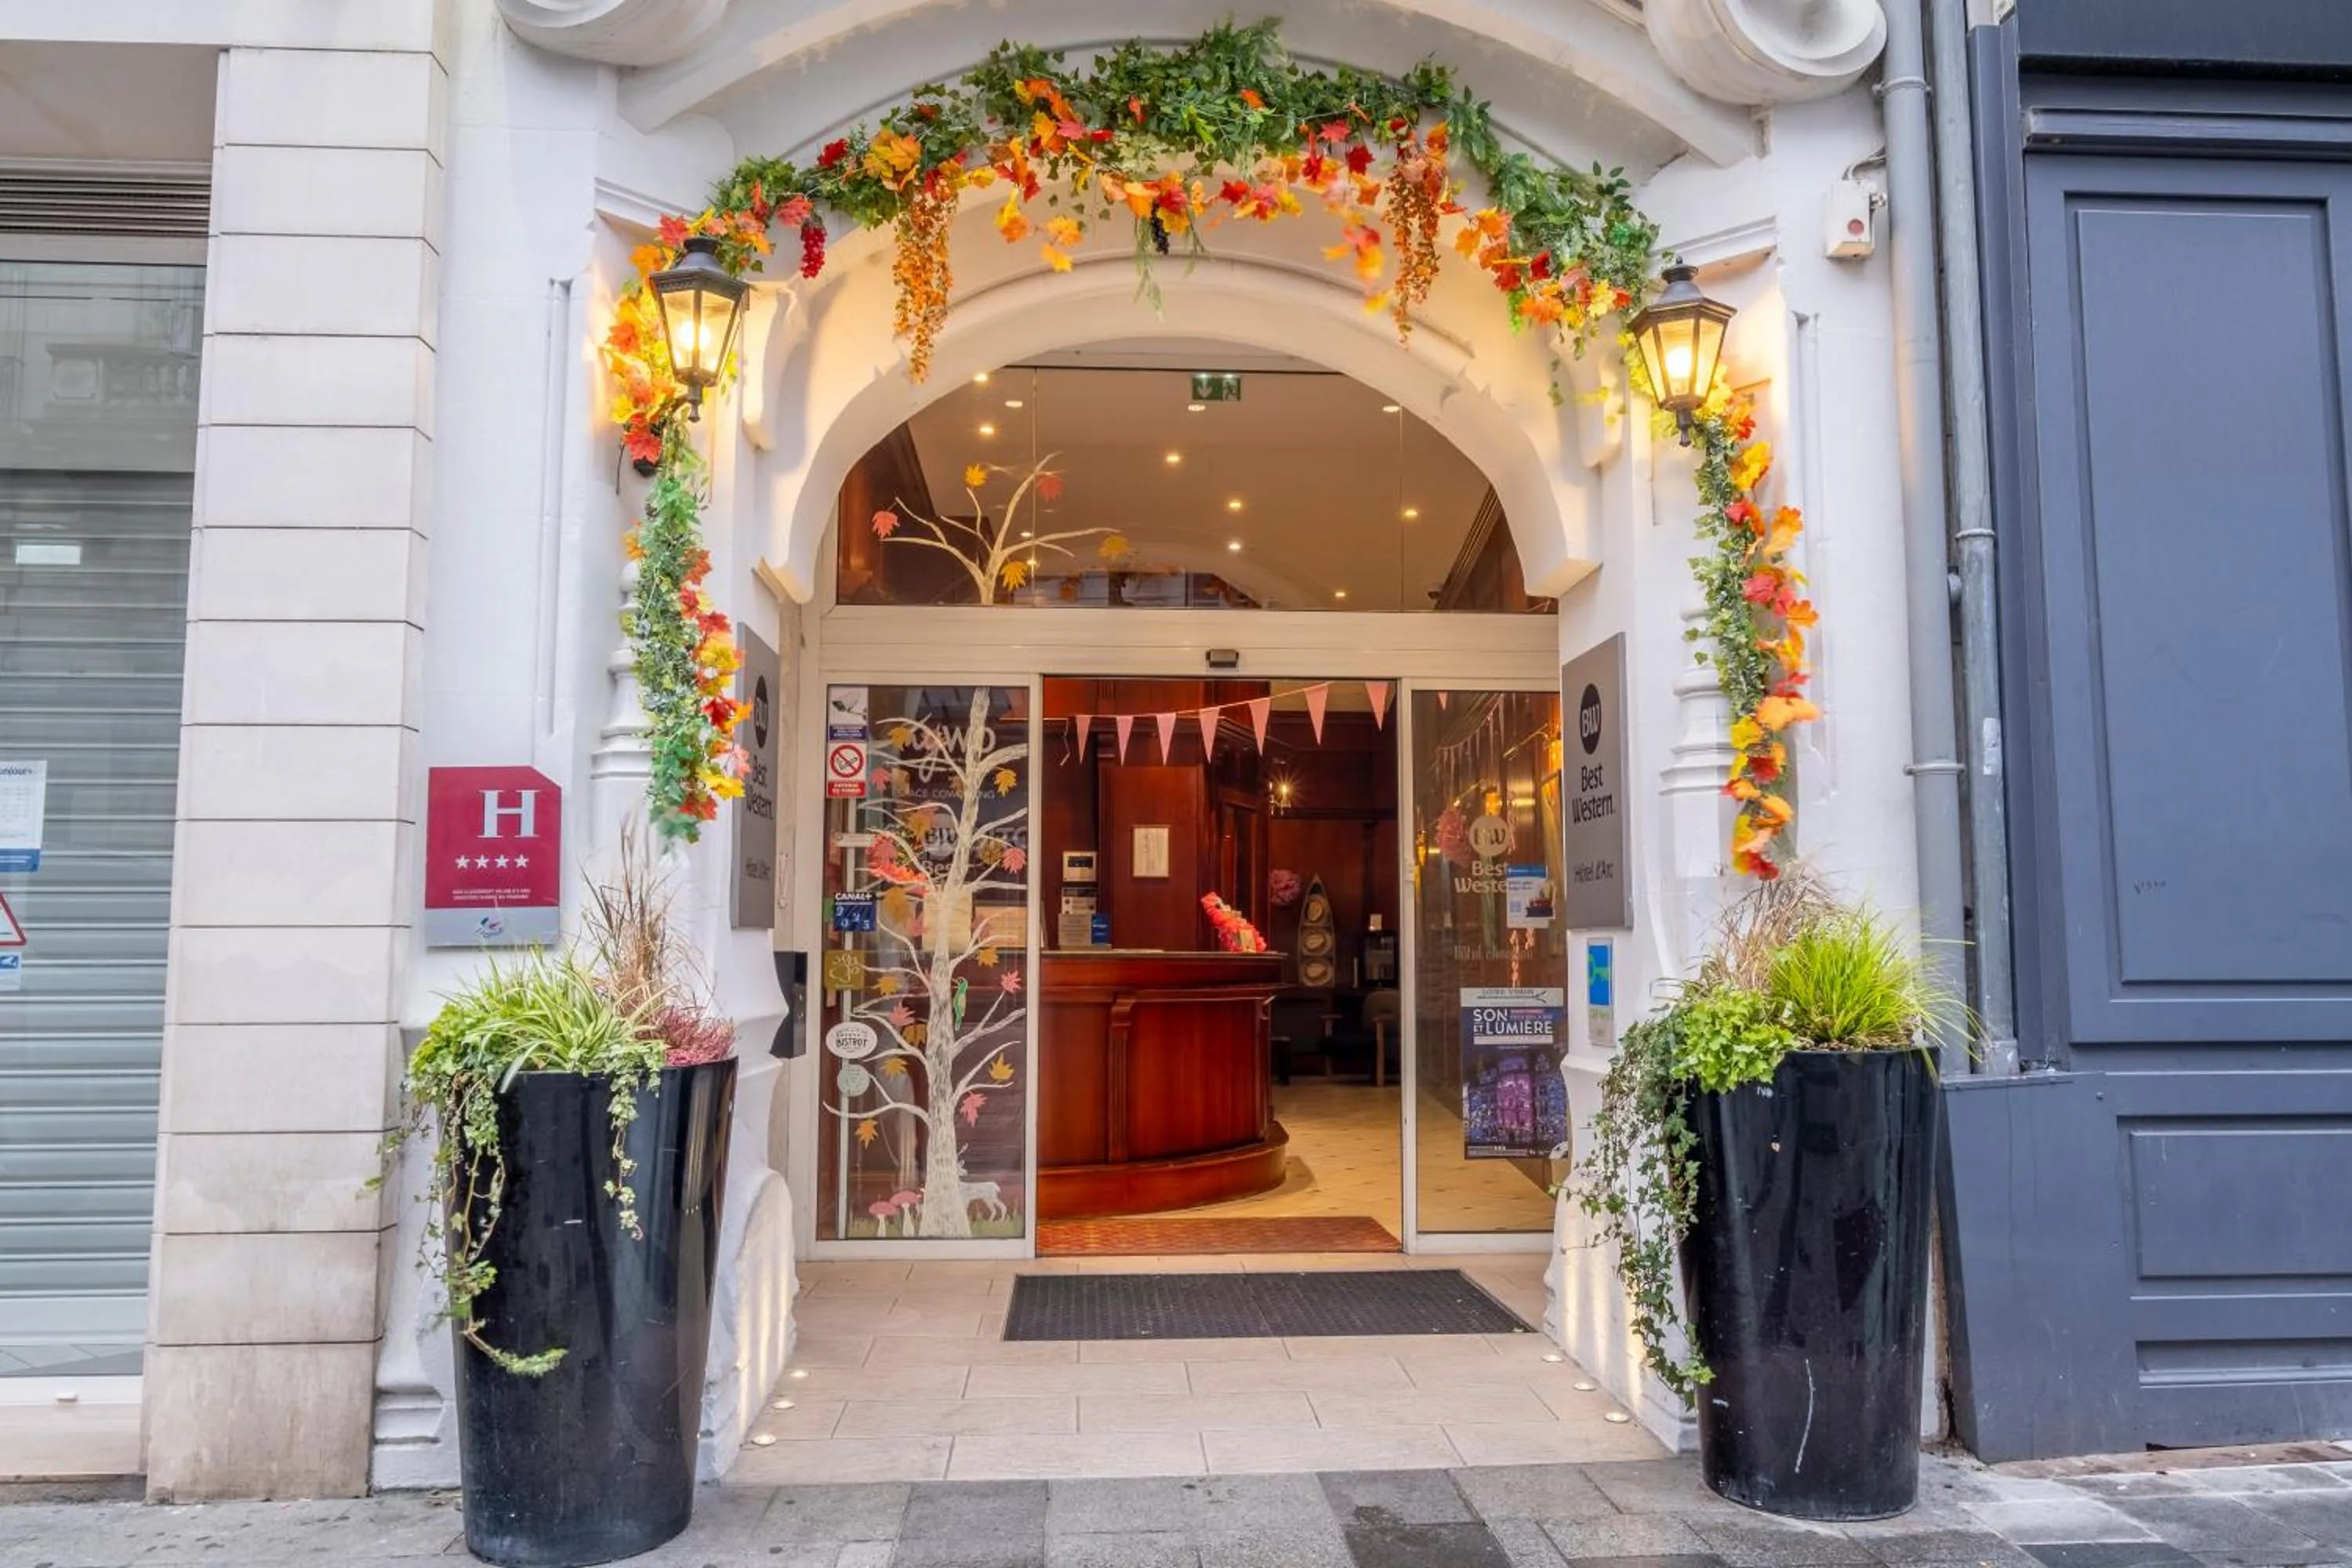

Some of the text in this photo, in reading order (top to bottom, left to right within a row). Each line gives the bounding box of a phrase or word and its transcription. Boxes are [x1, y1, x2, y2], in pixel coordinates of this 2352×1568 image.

[1581, 704, 1599, 738] BW
[1581, 763, 1604, 793] Best
[477, 789, 541, 838] H
[1572, 793, 1614, 824] Western
[920, 860, 952, 877] Bes
[835, 892, 873, 901] CANAL+
[1454, 877, 1508, 894] Weste
[1473, 1008, 1508, 1022] SON
